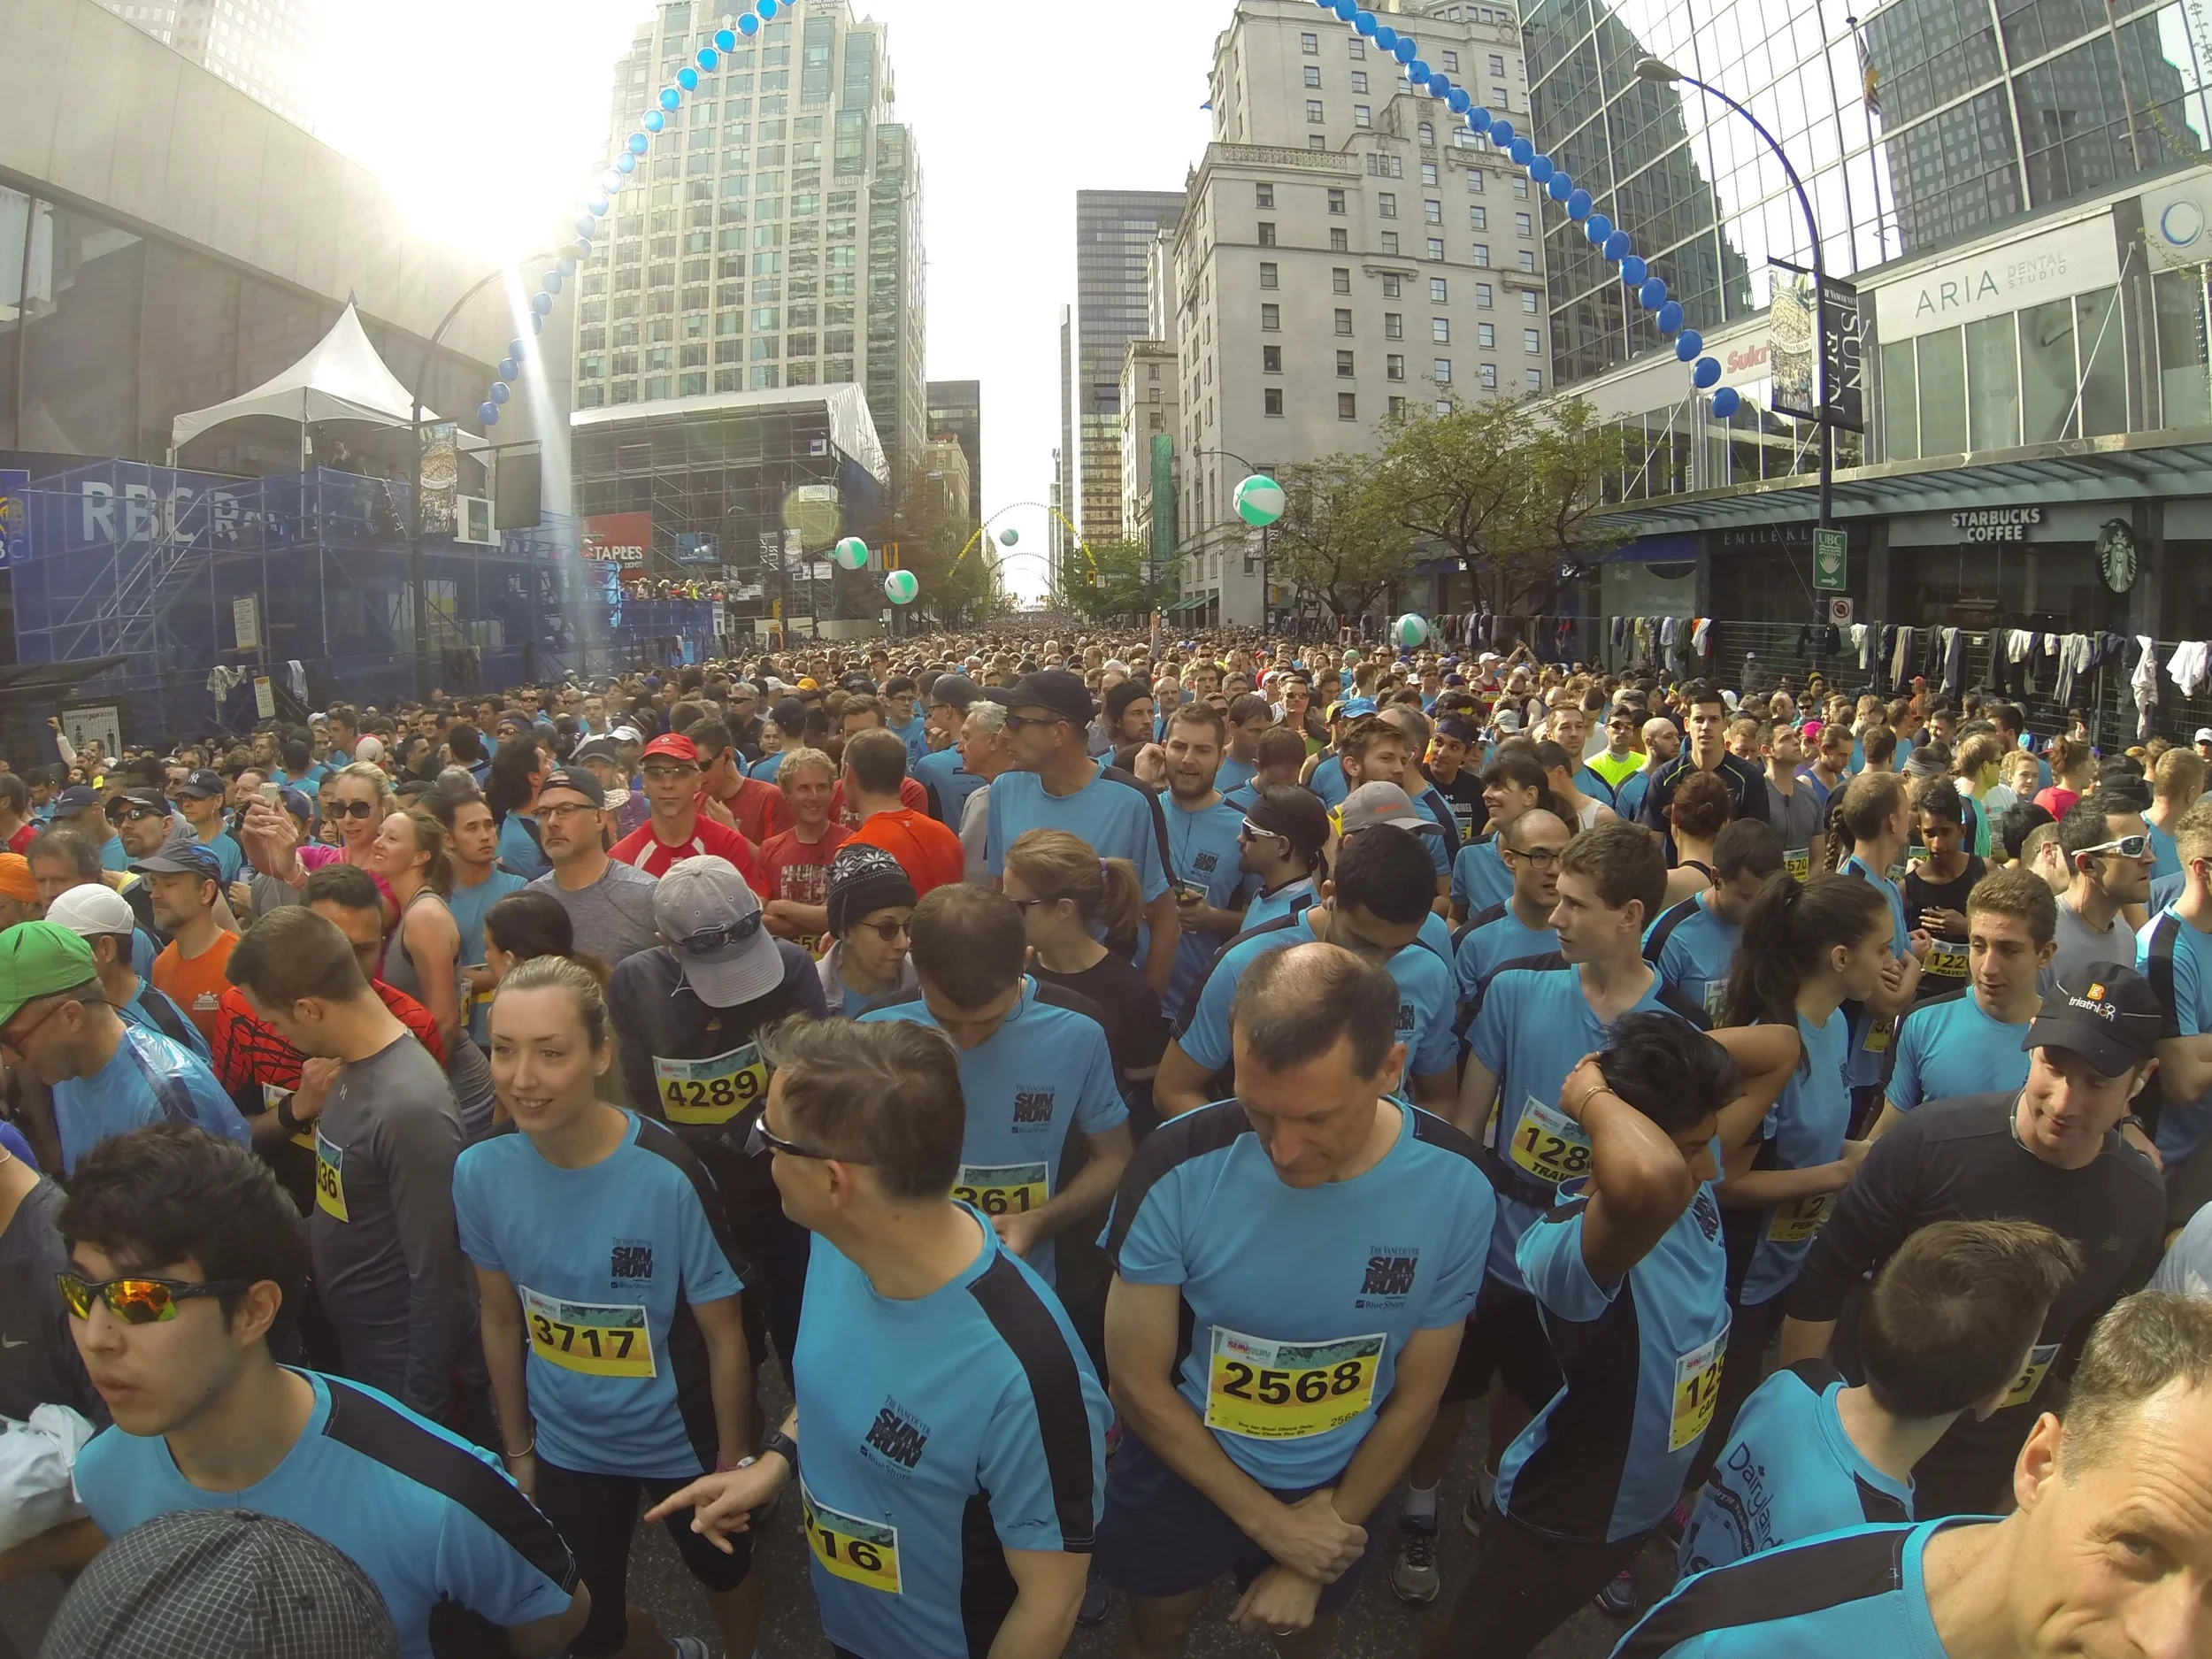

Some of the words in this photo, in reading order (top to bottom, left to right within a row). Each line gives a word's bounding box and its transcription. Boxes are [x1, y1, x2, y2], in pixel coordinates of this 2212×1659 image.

[2007, 251, 2067, 278] DENTAL
[2008, 265, 2067, 288] STUDIO
[1915, 270, 1999, 319] ARIA
[1840, 312, 1863, 391] SUN
[82, 480, 196, 542] RBC
[1951, 508, 2040, 527] STARBUCKS
[1724, 532, 1778, 545] EMILE
[1819, 533, 1842, 546] UBC
[1967, 525, 2023, 541] COFFEE
[1932, 952, 1970, 969] 122
[667, 1070, 758, 1107] 4289
[1015, 1093, 1055, 1107] SUN
[1013, 1102, 1054, 1123] RUN
[1525, 1126, 1592, 1171] 128
[611, 1247, 652, 1262] SUN
[1383, 1246, 1419, 1256] VANCOUVER
[611, 1256, 653, 1279] RUN
[1367, 1256, 1417, 1274] SUN
[1360, 1269, 1416, 1294] RUN
[534, 1314, 634, 1359] 3717
[1223, 1361, 1362, 1405] 2568
[879, 1408, 927, 1449] SUN
[896, 1402, 931, 1436] VANCOUVER
[865, 1416, 922, 1469] RUN
